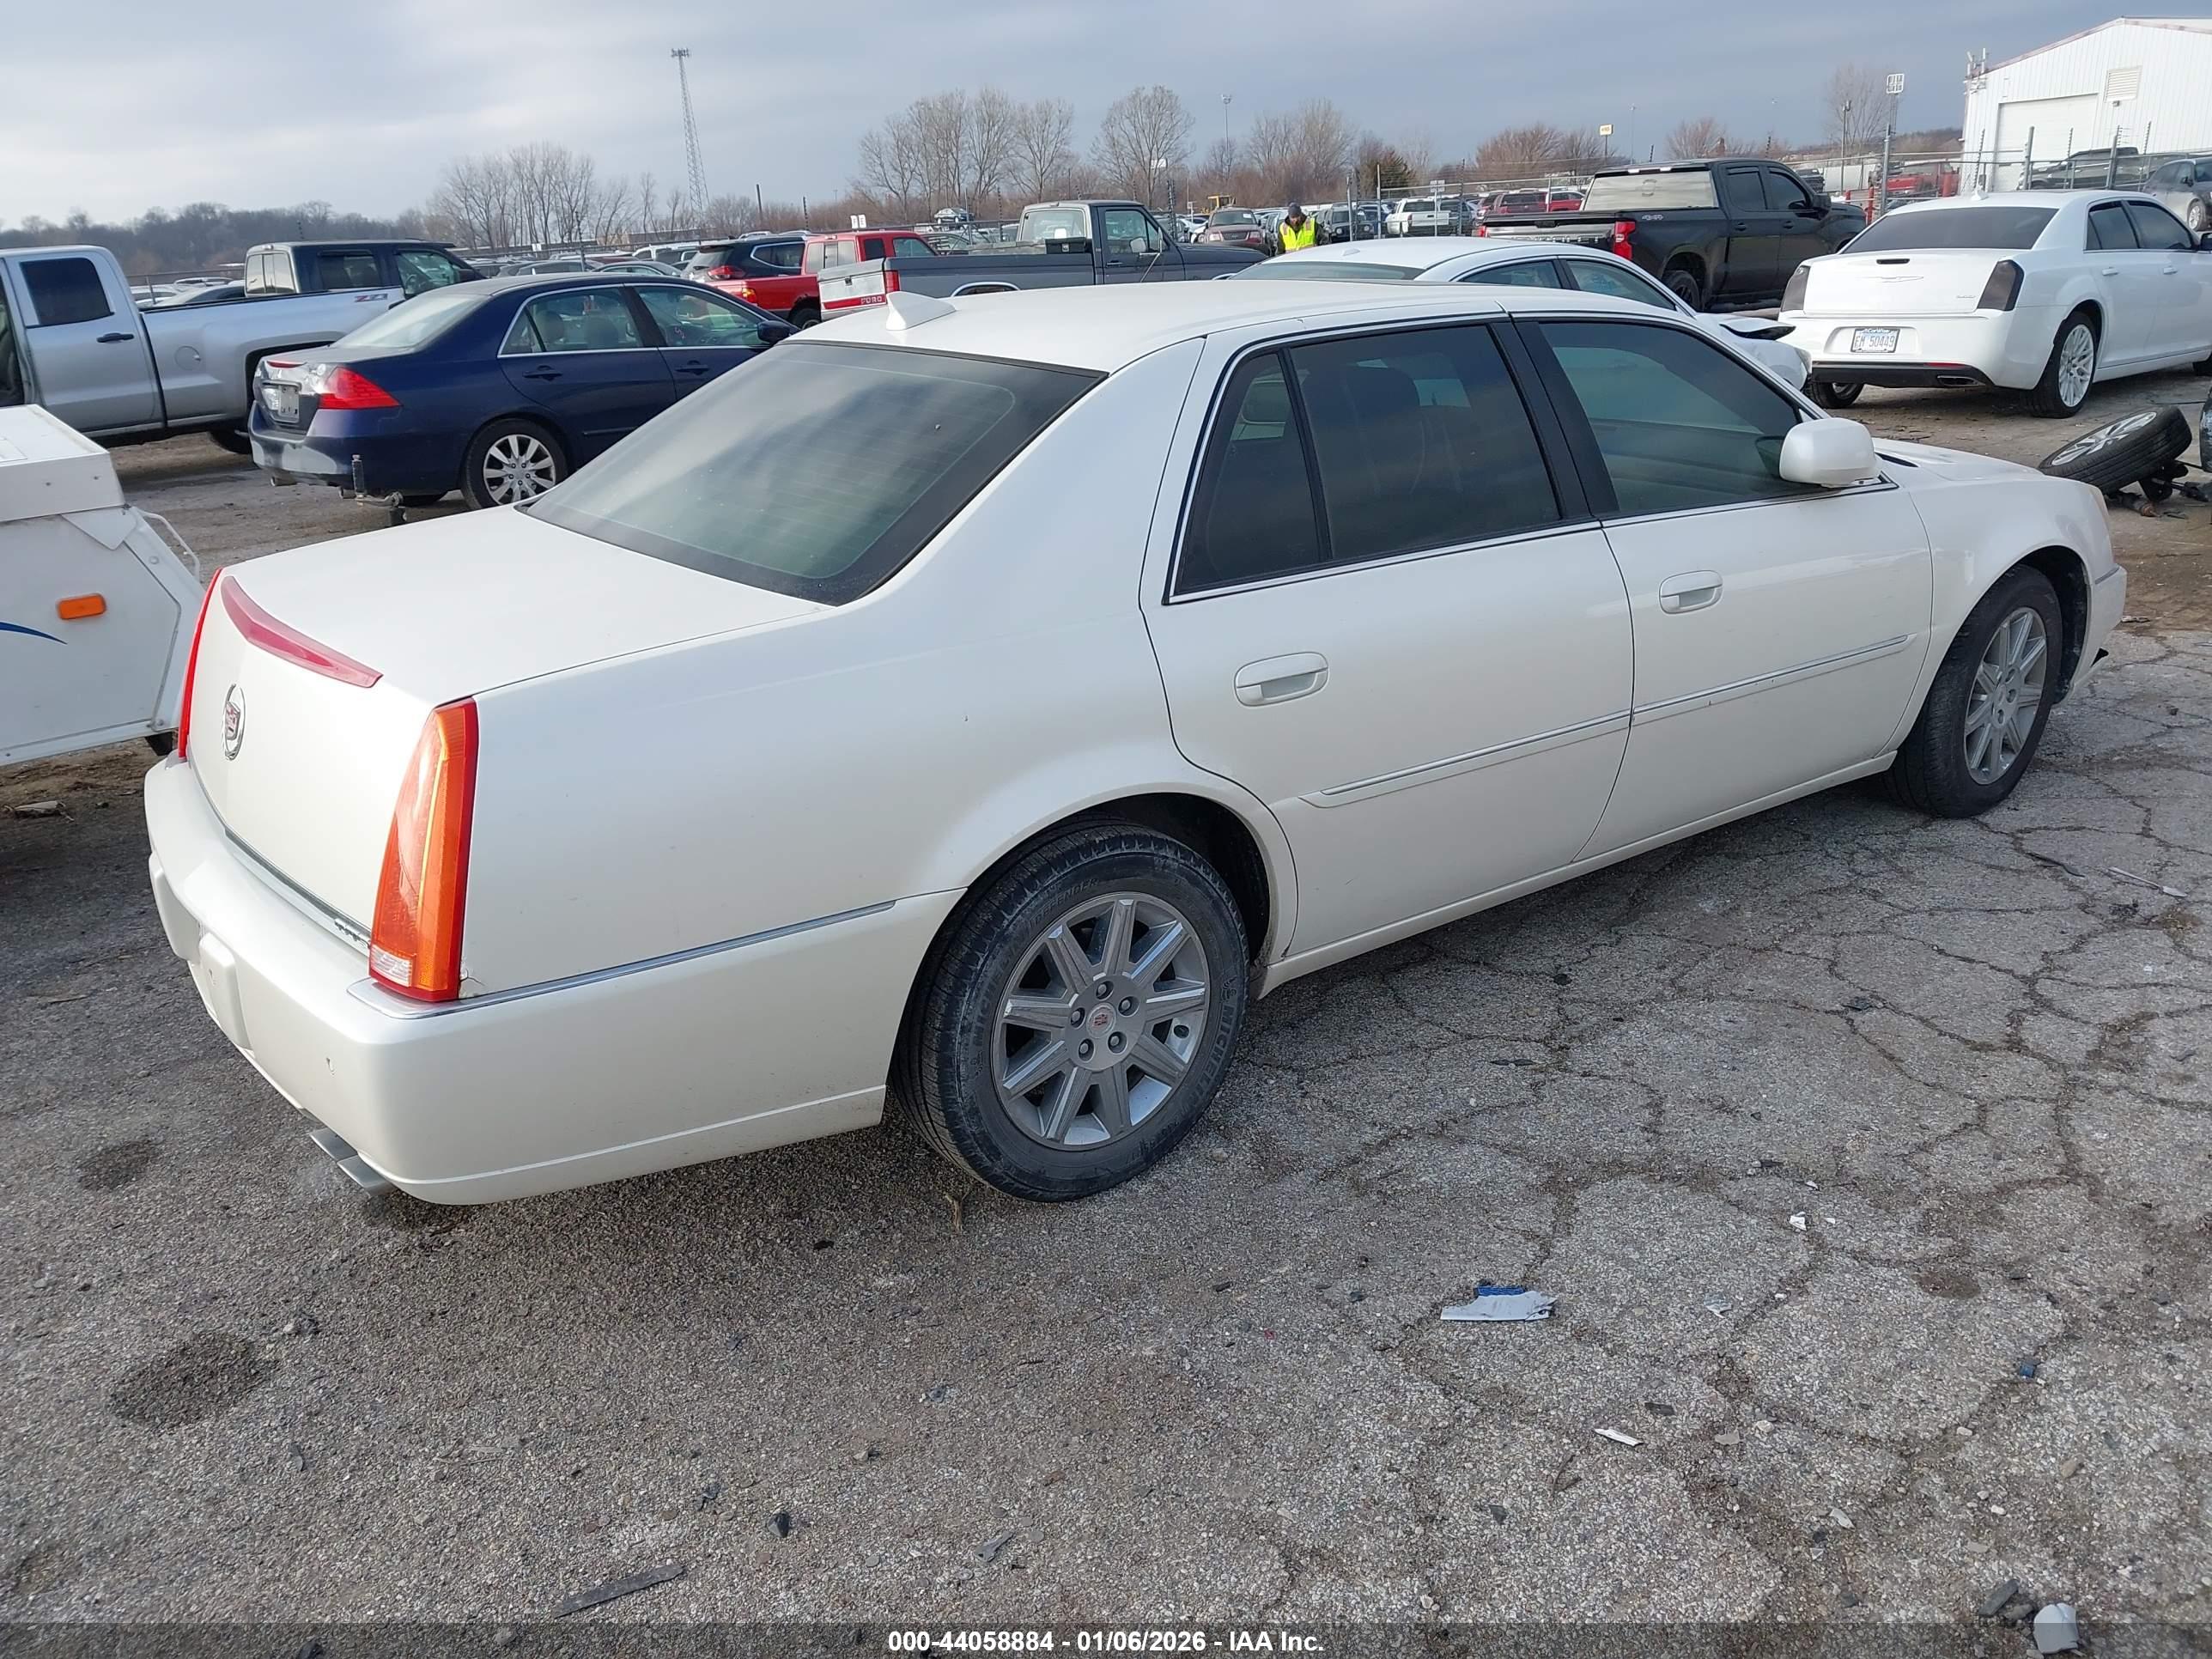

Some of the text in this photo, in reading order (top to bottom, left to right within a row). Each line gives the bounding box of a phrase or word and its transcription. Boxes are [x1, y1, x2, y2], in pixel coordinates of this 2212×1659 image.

[860, 295, 883, 305] FORD
[1869, 336, 1895, 348] 50449
[1033, 878, 1098, 923] DEFENDER
[1186, 1003, 1235, 1109] MICHELIN
